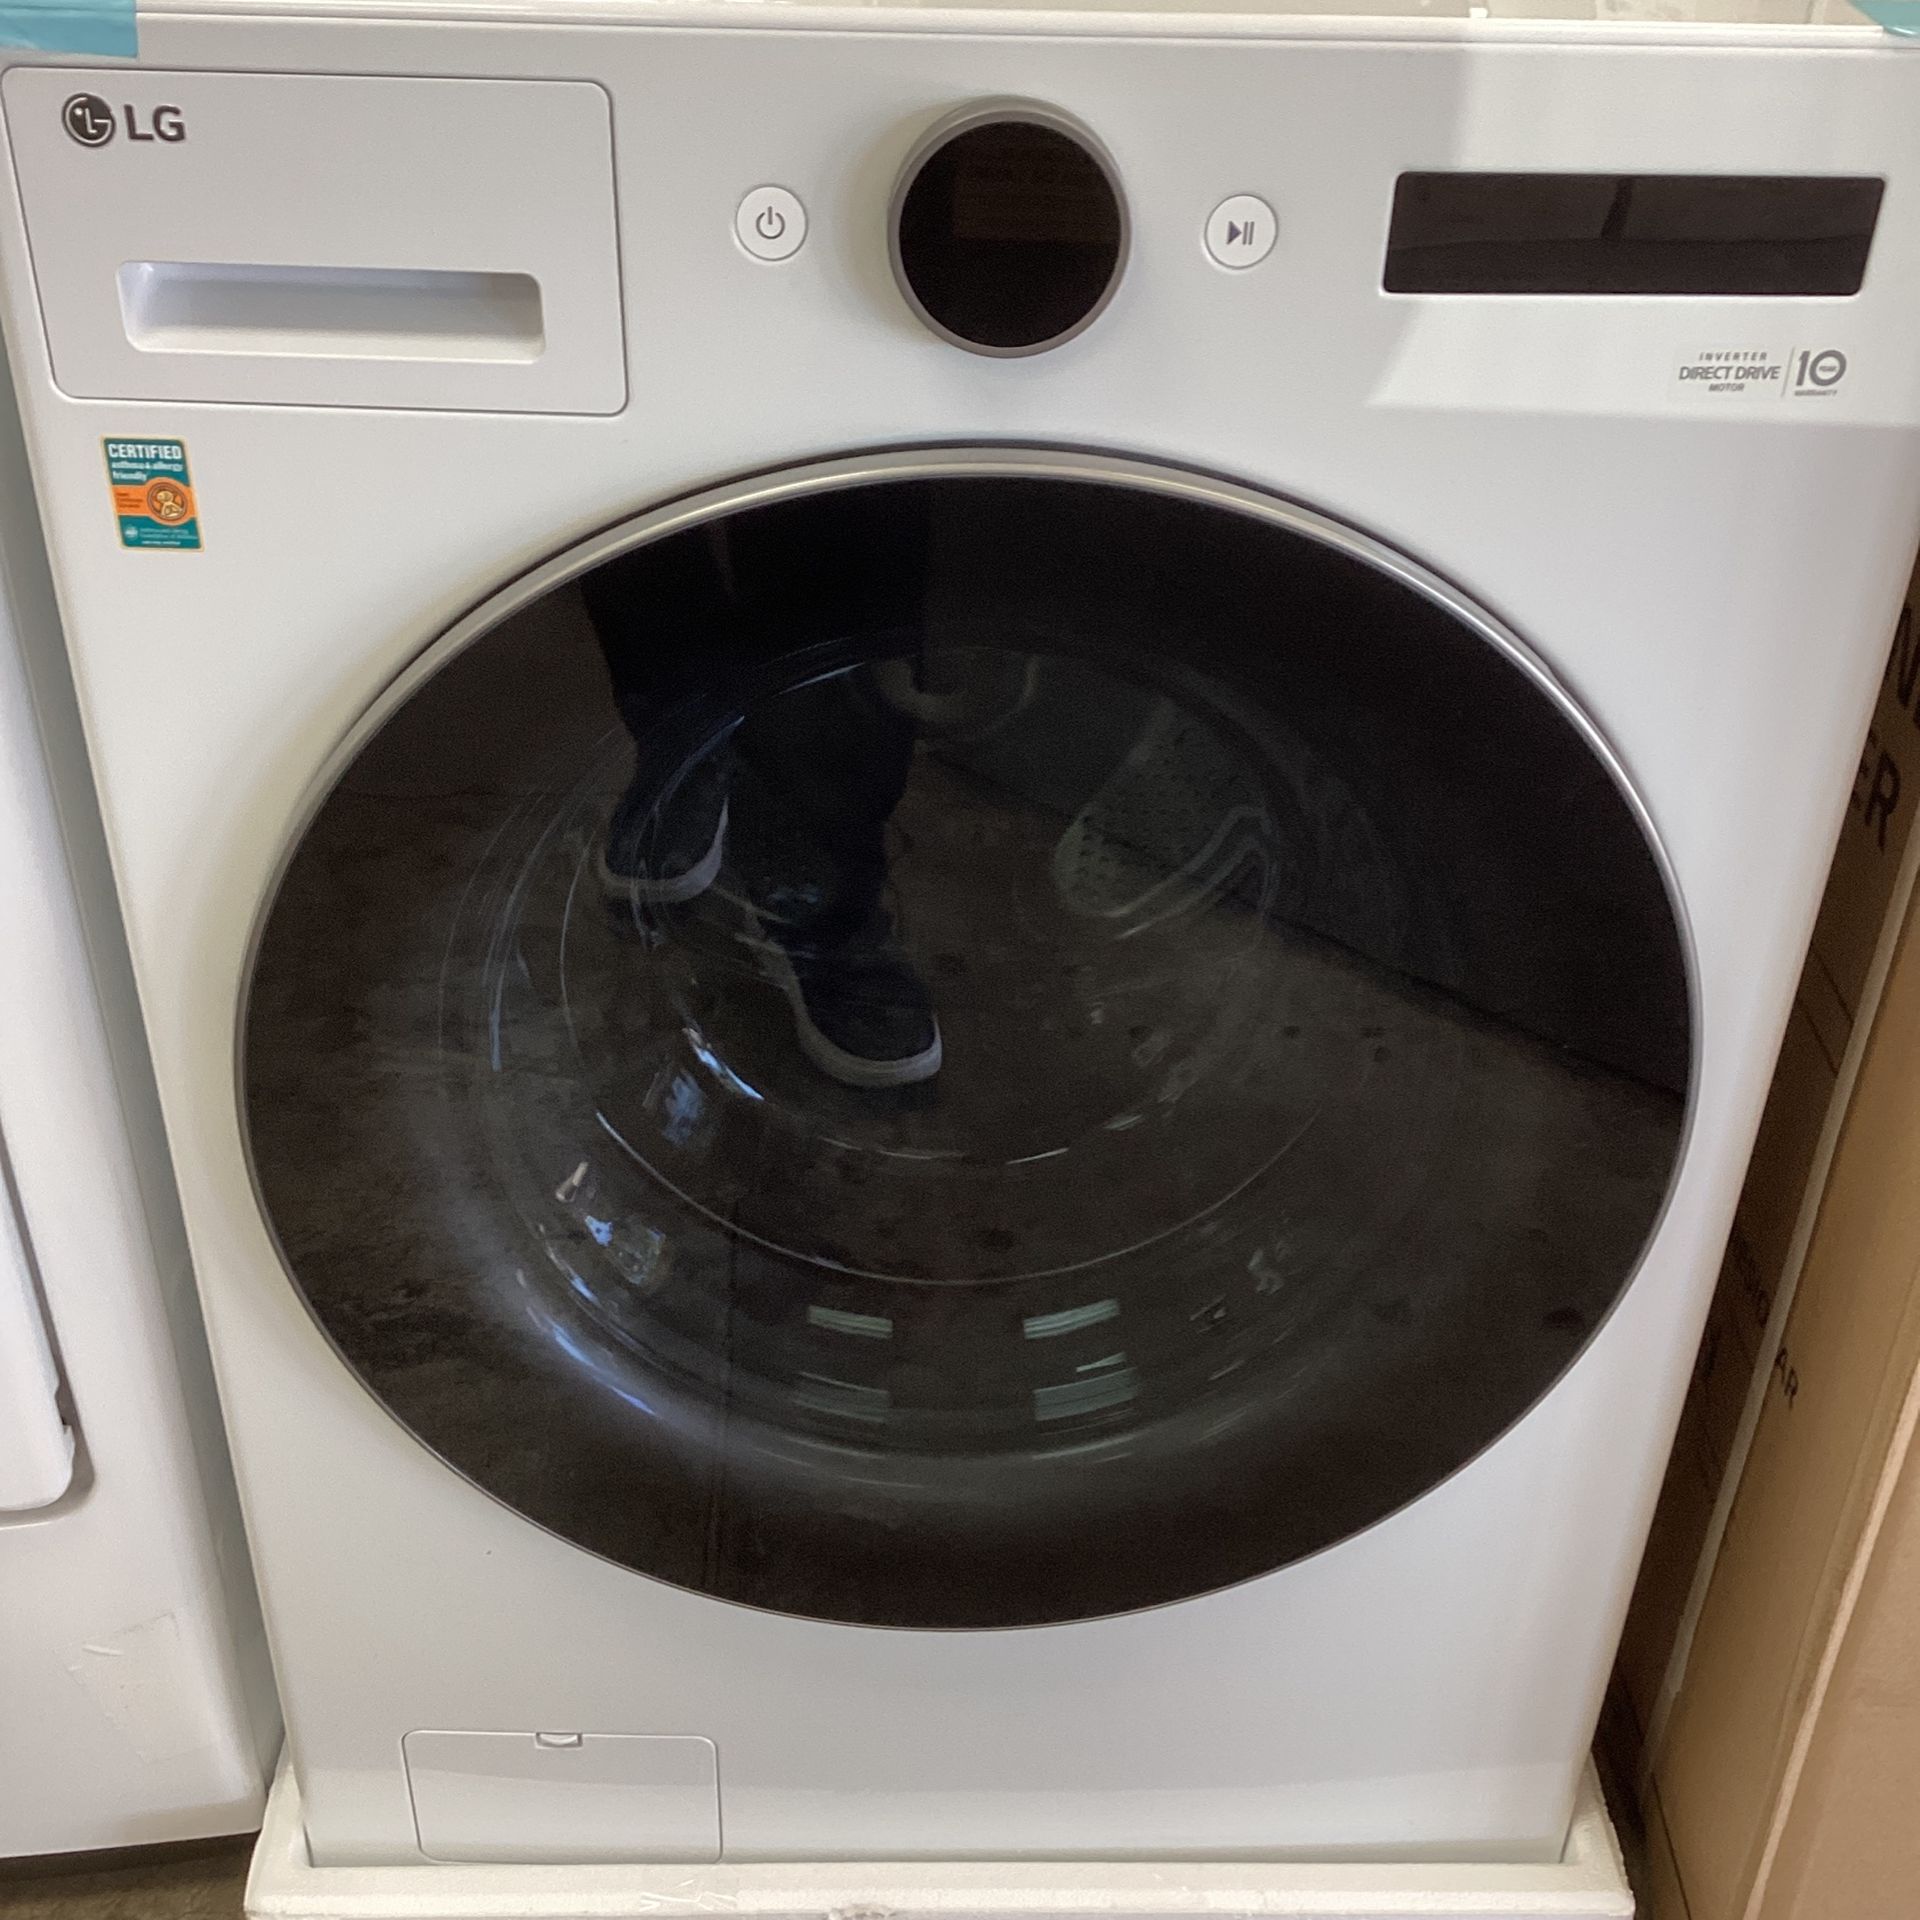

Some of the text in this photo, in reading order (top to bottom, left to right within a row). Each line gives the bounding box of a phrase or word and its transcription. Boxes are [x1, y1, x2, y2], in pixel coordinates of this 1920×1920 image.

[123, 103, 186, 143] LG
[1699, 351, 1769, 361] INVERTER
[1679, 365, 1782, 380] DIRECT DRIVE
[1795, 349, 1848, 387] 10
[1708, 382, 1745, 392] MOTOR
[108, 443, 182, 460] CERTIFIED
